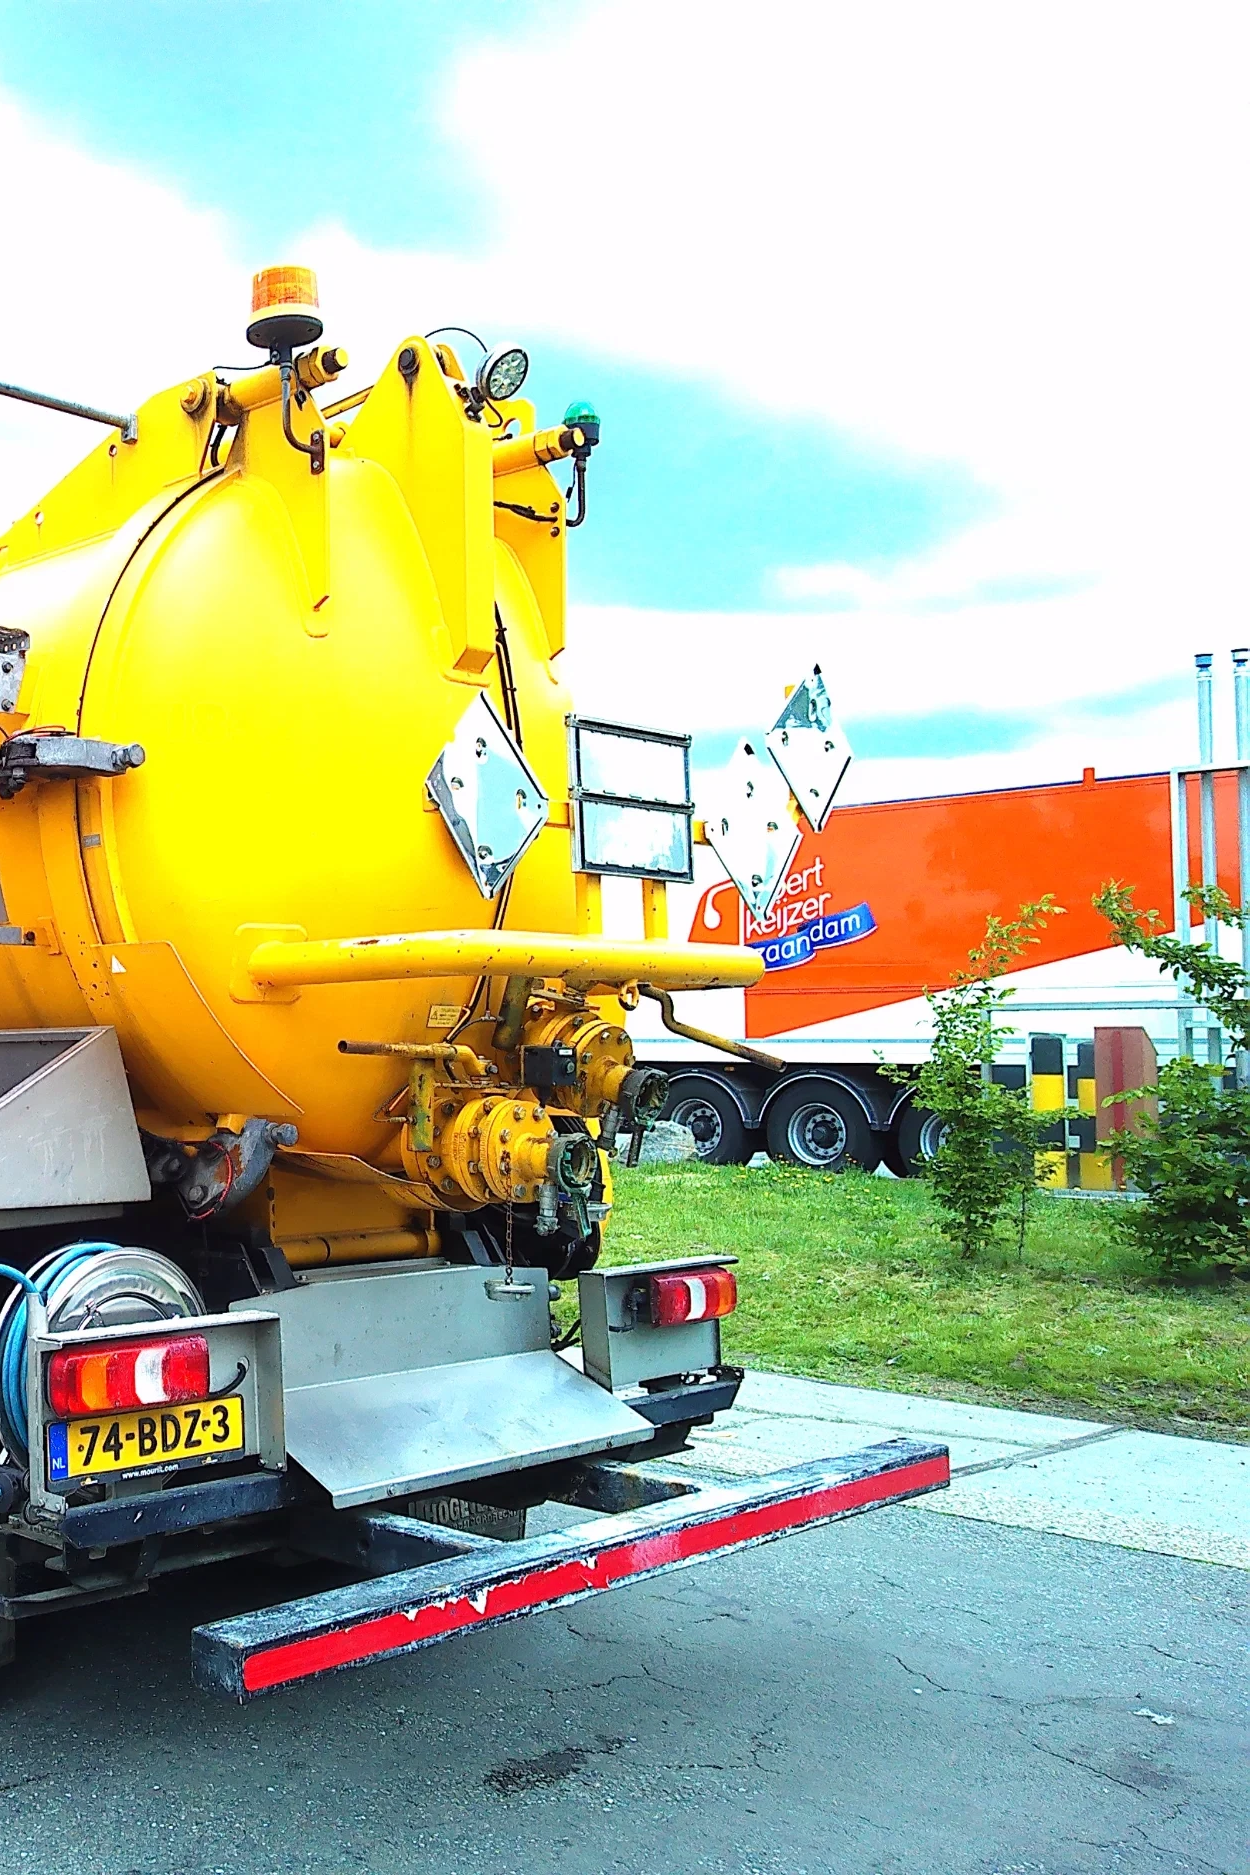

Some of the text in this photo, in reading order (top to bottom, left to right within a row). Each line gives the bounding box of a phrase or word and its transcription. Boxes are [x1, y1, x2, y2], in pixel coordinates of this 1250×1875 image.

[746, 892, 832, 939] keijzer
[79, 1404, 230, 1467] 74-BDZ-3
[52, 1458, 66, 1470] NL
